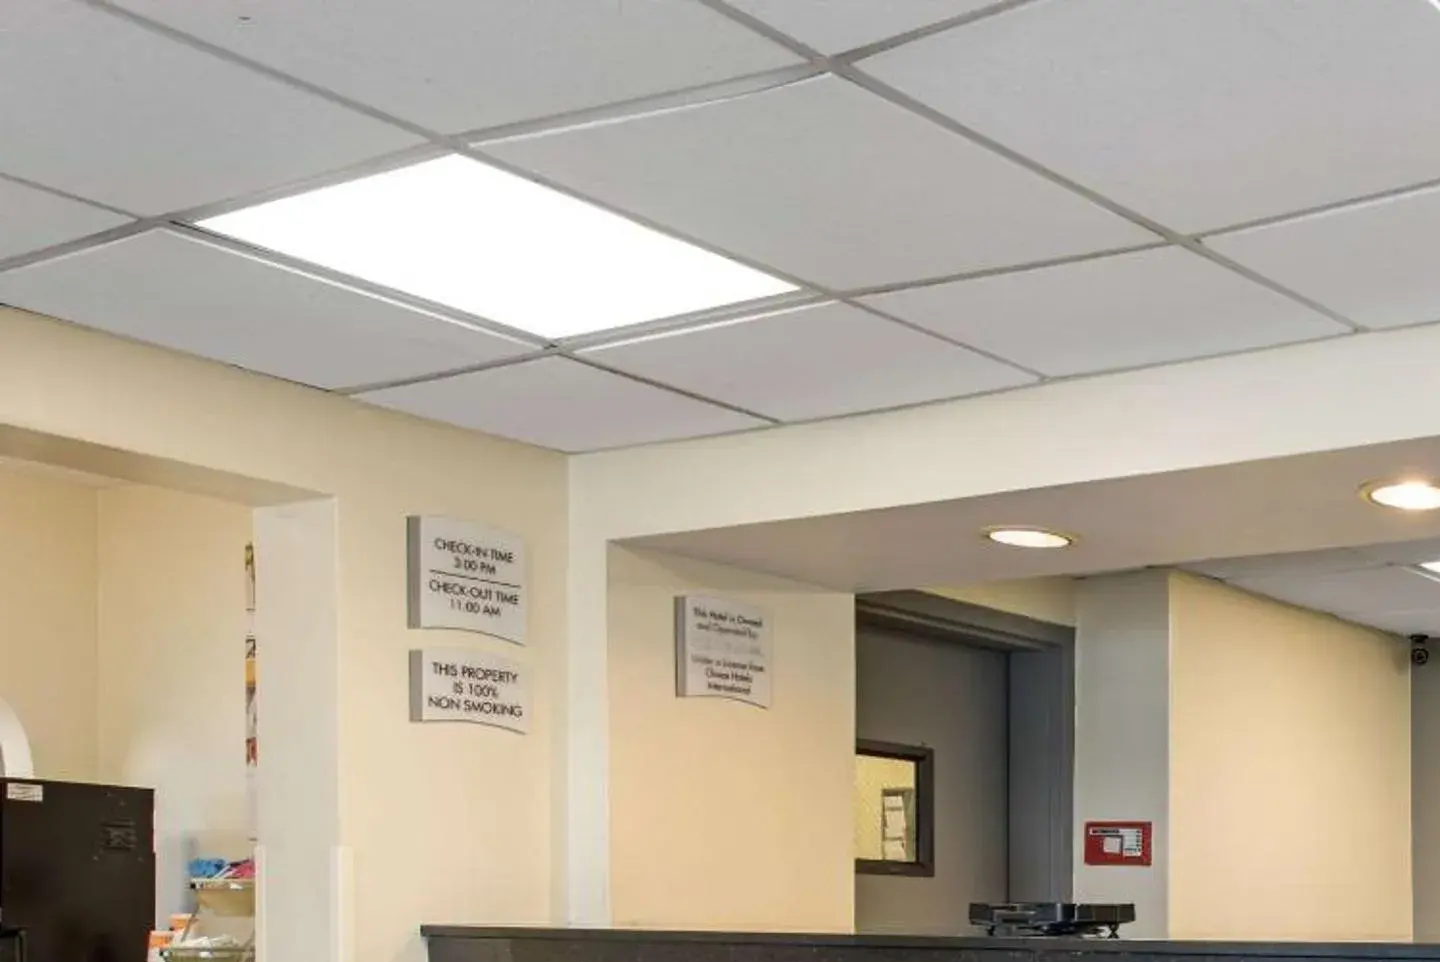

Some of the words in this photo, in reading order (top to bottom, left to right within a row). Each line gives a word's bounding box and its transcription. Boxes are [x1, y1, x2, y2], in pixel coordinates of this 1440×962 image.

[435, 538, 488, 558] CHECK-IN
[490, 548, 514, 563] TIME
[454, 556, 478, 571] 300
[480, 561, 496, 575] PM
[429, 579, 492, 600] CHECK-OUT
[496, 590, 519, 605] TIME
[483, 605, 501, 617] AM
[432, 662, 458, 677] THIS
[461, 665, 518, 683] PROPERTY
[453, 680, 463, 695] IS
[469, 683, 499, 698] 100%
[428, 696, 460, 710] NON
[463, 699, 523, 718] SMOKING
